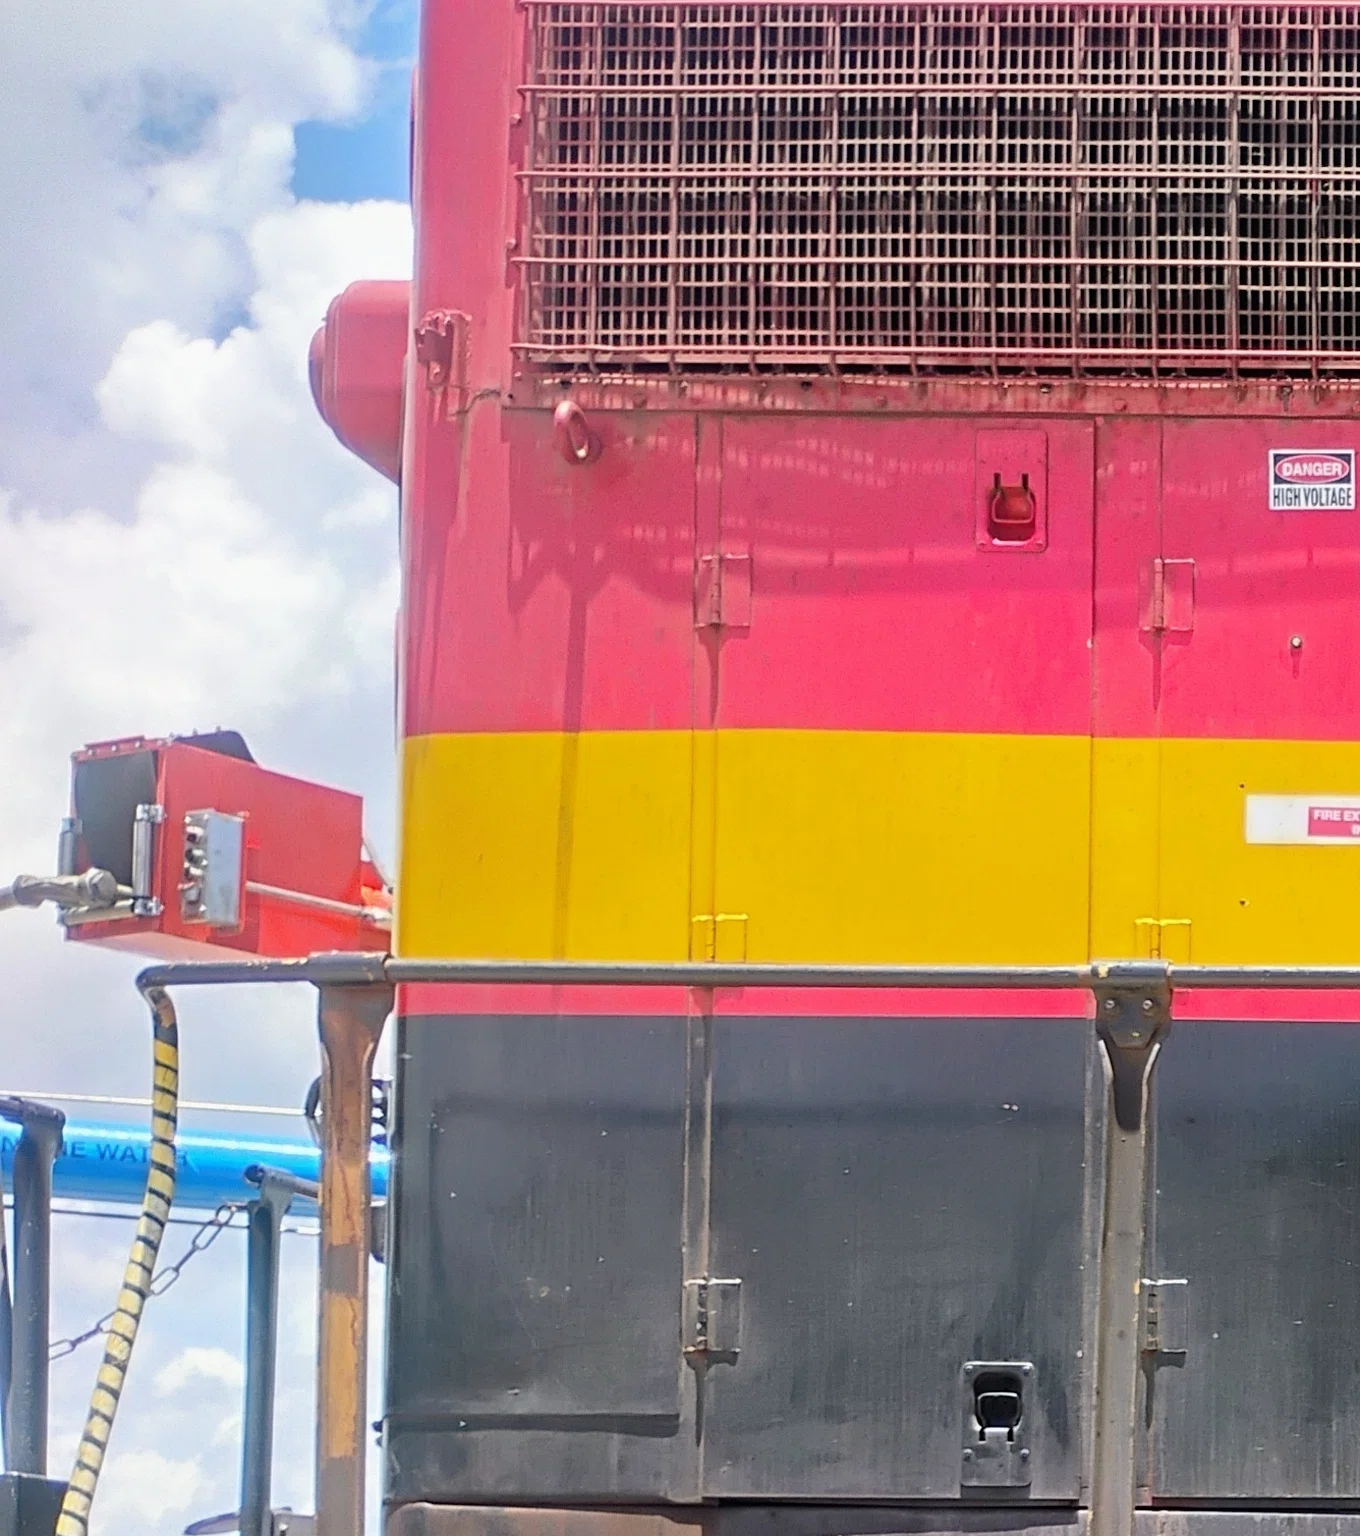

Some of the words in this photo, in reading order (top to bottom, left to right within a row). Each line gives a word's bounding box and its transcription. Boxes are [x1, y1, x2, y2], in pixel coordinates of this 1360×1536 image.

[1282, 462, 1342, 476] DANGER
[1273, 488, 1301, 507] HIGH
[1303, 488, 1352, 507] VOLTAGE
[1314, 810, 1341, 821] FIRE
